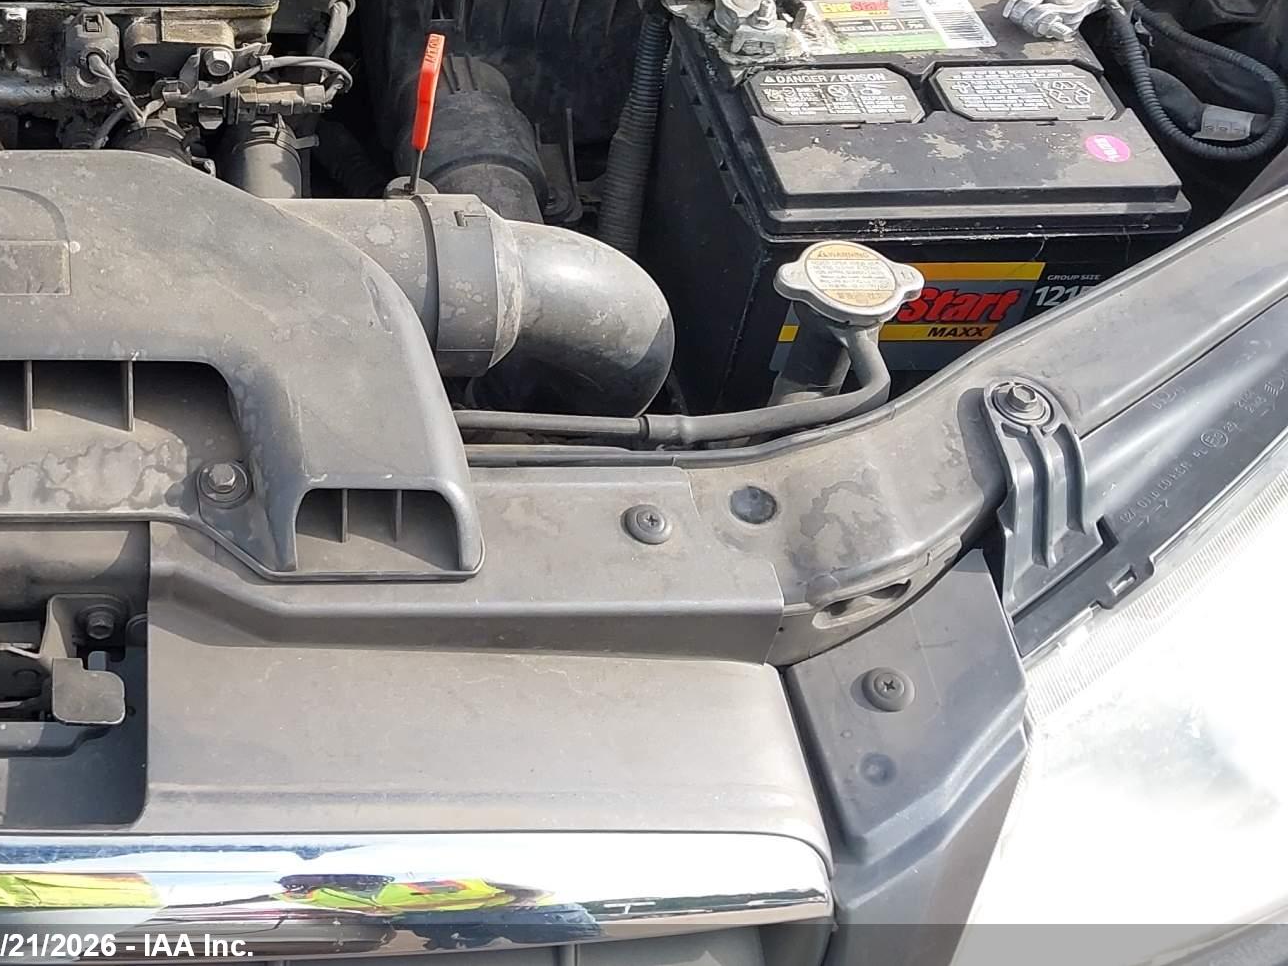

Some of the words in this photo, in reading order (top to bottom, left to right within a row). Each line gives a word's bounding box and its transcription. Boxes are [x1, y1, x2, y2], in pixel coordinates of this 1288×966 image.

[775, 75, 828, 84] DANGER
[838, 73, 887, 82] POISON
[927, 326, 988, 337] MAXX
